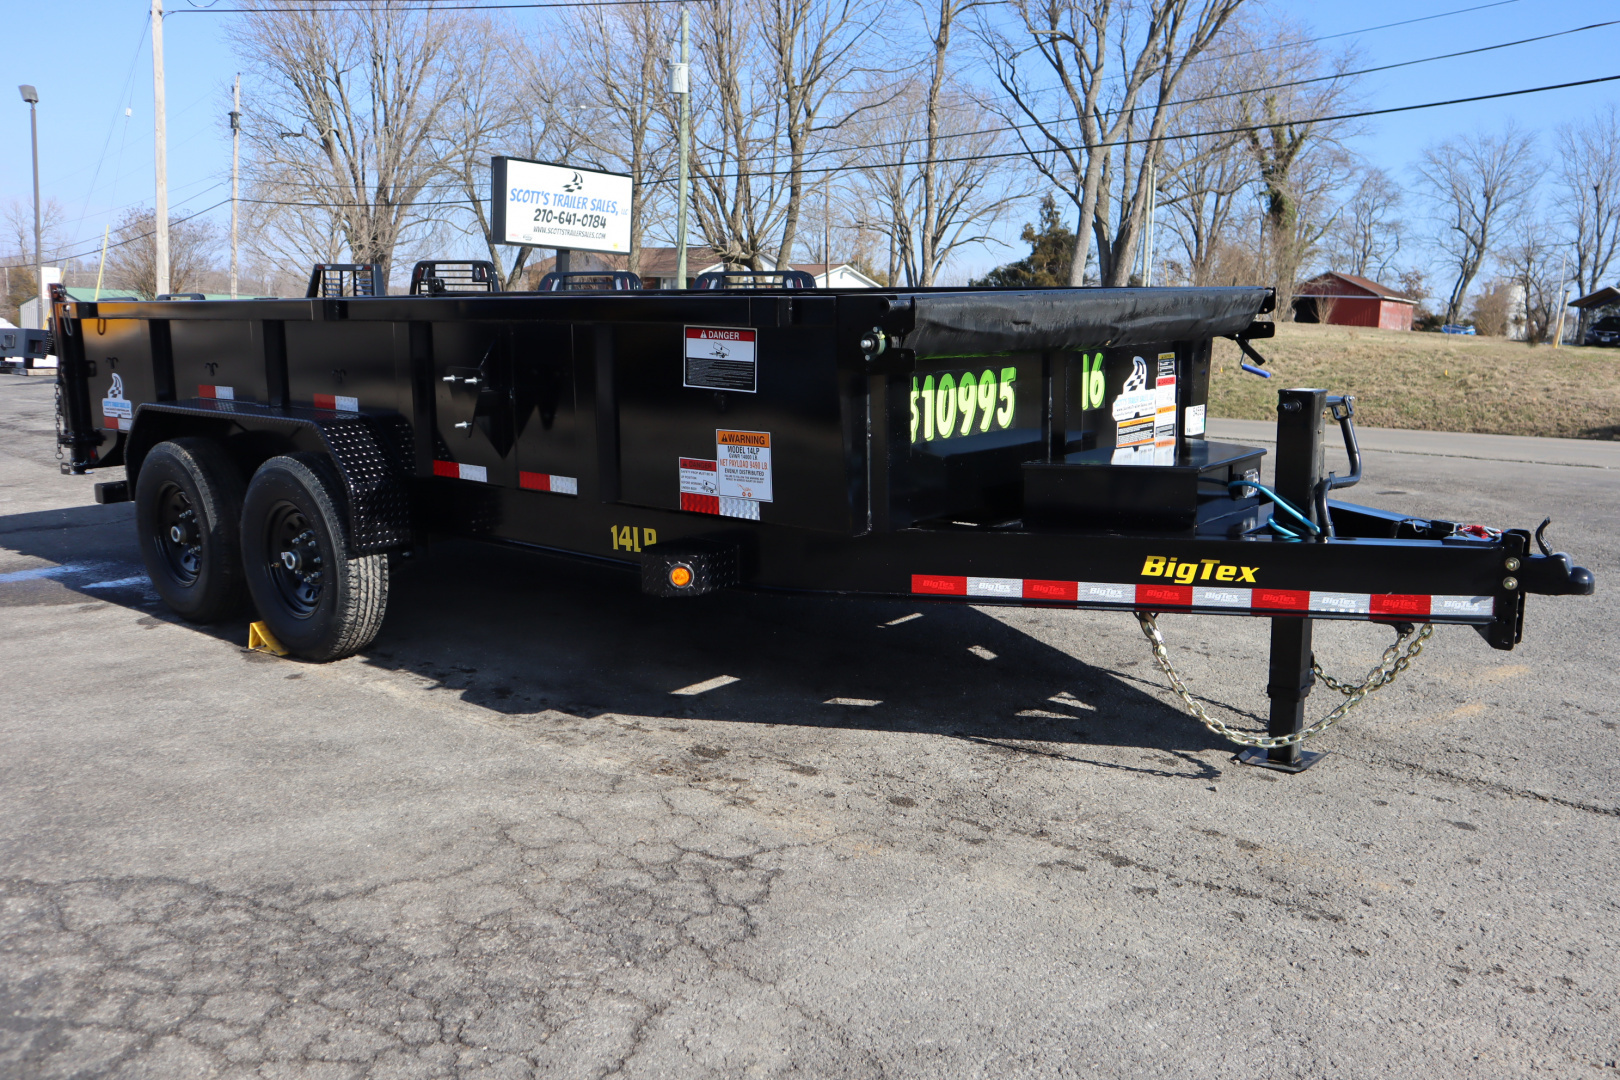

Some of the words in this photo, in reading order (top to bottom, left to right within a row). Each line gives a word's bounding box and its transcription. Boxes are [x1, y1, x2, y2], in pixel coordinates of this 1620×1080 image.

[510, 188, 551, 206] SCOTT'S
[552, 193, 588, 210] TRAILER
[590, 198, 619, 216] SALES,
[533, 208, 607, 229] 270-641-0784
[533, 226, 606, 239] WWW.SCOTTSTRAILERSALES.COM
[708, 330, 740, 340] DANGER
[1082, 352, 1105, 410] 16
[728, 434, 765, 445] WARNING
[728, 446, 745, 454] MODEL
[747, 447, 760, 455] 14LP
[689, 461, 713, 469] DANGER
[729, 459, 748, 468] PAYLOAD
[611, 524, 656, 552] 14LP
[1140, 555, 1260, 584] BigTex
